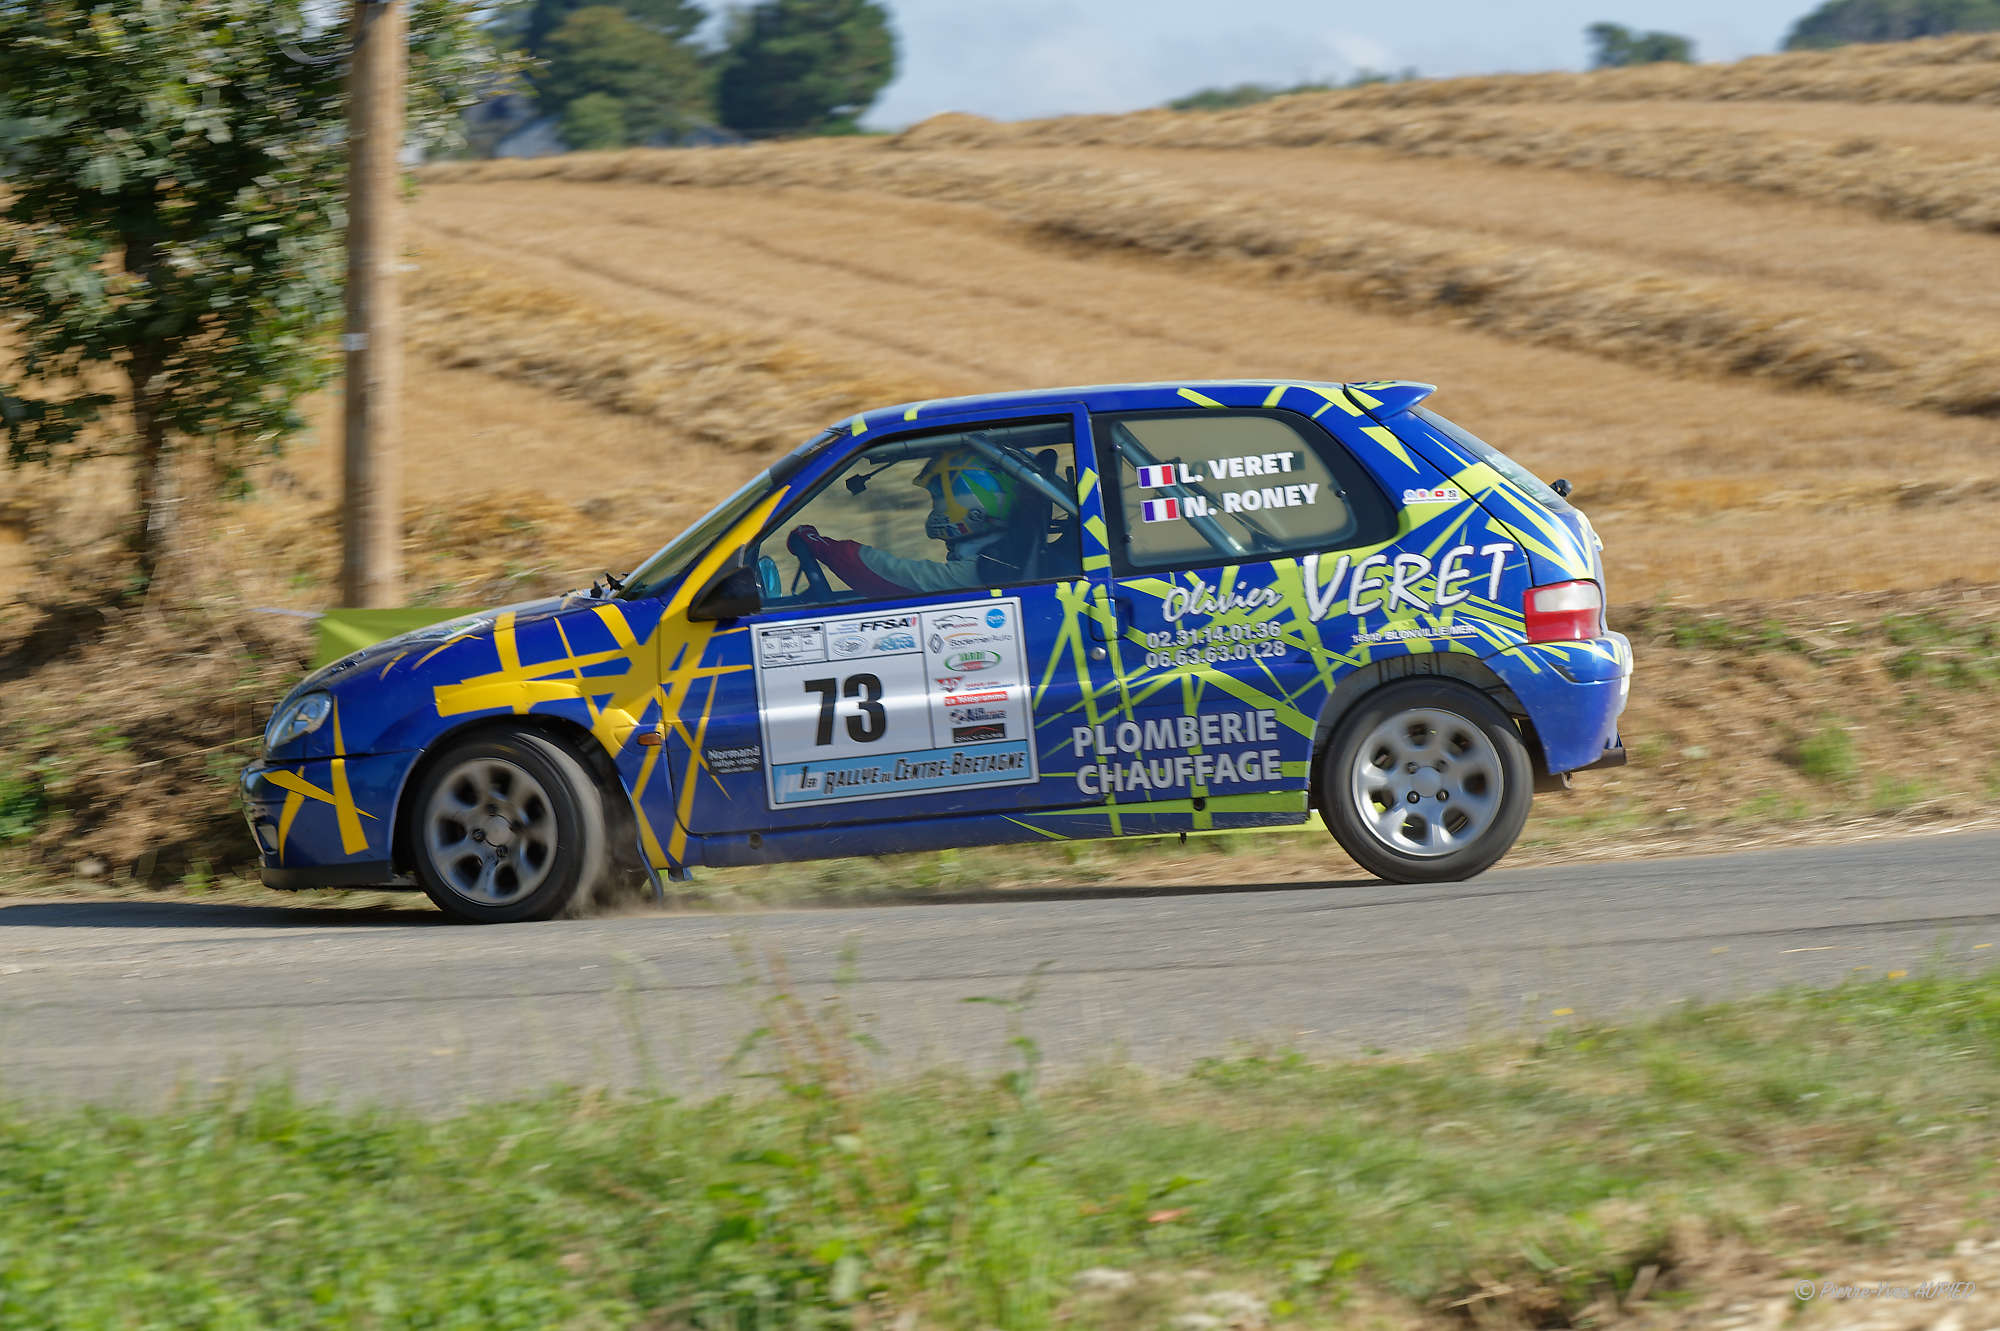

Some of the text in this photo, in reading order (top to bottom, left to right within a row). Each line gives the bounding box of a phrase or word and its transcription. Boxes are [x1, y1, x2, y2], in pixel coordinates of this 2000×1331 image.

[1177, 450, 1294, 484] L. VERET
[1183, 482, 1320, 519] N. RONEY
[1162, 581, 1283, 622] Olivier
[1303, 543, 1514, 621] VERET
[1144, 639, 1287, 669] 06.63.63.01.28
[1145, 620, 1282, 649] 02.31.14.01.36
[804, 673, 885, 746] 73
[1072, 709, 1279, 758] PLOMBERIE
[1076, 748, 1283, 795] CHAUFFAGE
